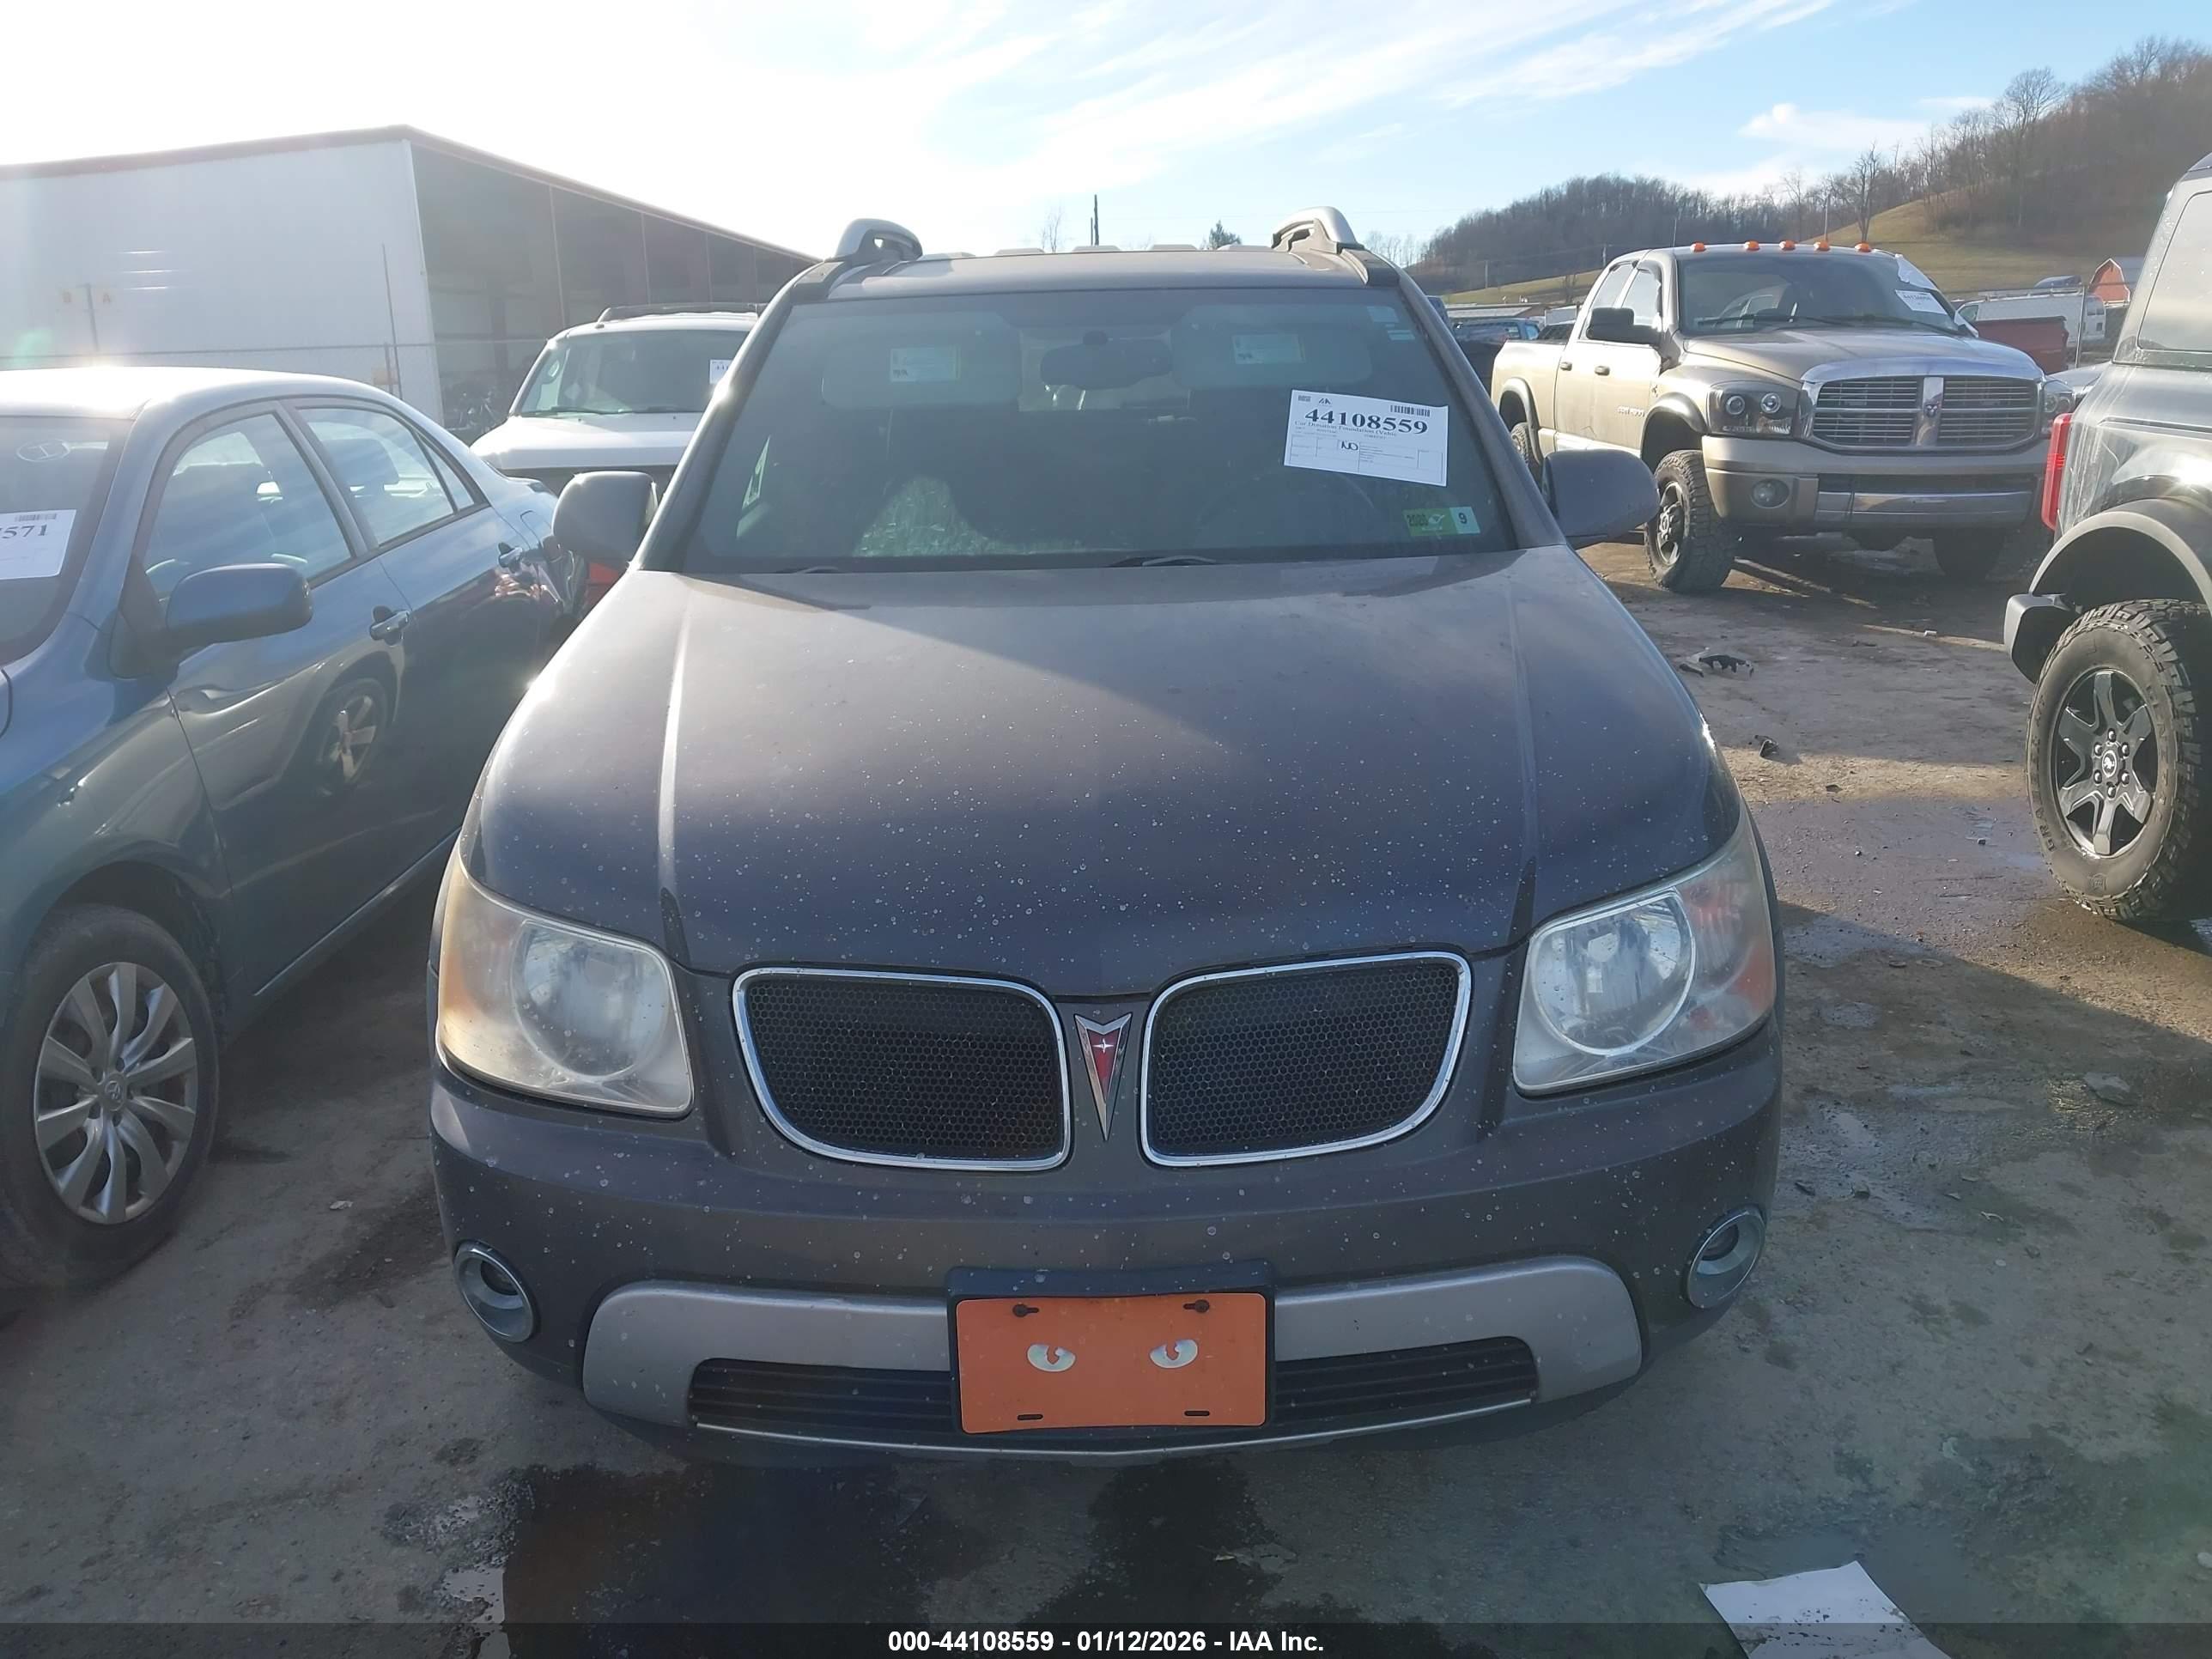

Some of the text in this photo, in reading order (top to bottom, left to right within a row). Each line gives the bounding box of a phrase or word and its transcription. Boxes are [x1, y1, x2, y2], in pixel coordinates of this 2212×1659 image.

[1304, 408, 1429, 434] 44108559
[1458, 512, 1468, 525] 9
[0, 524, 47, 539] 571
